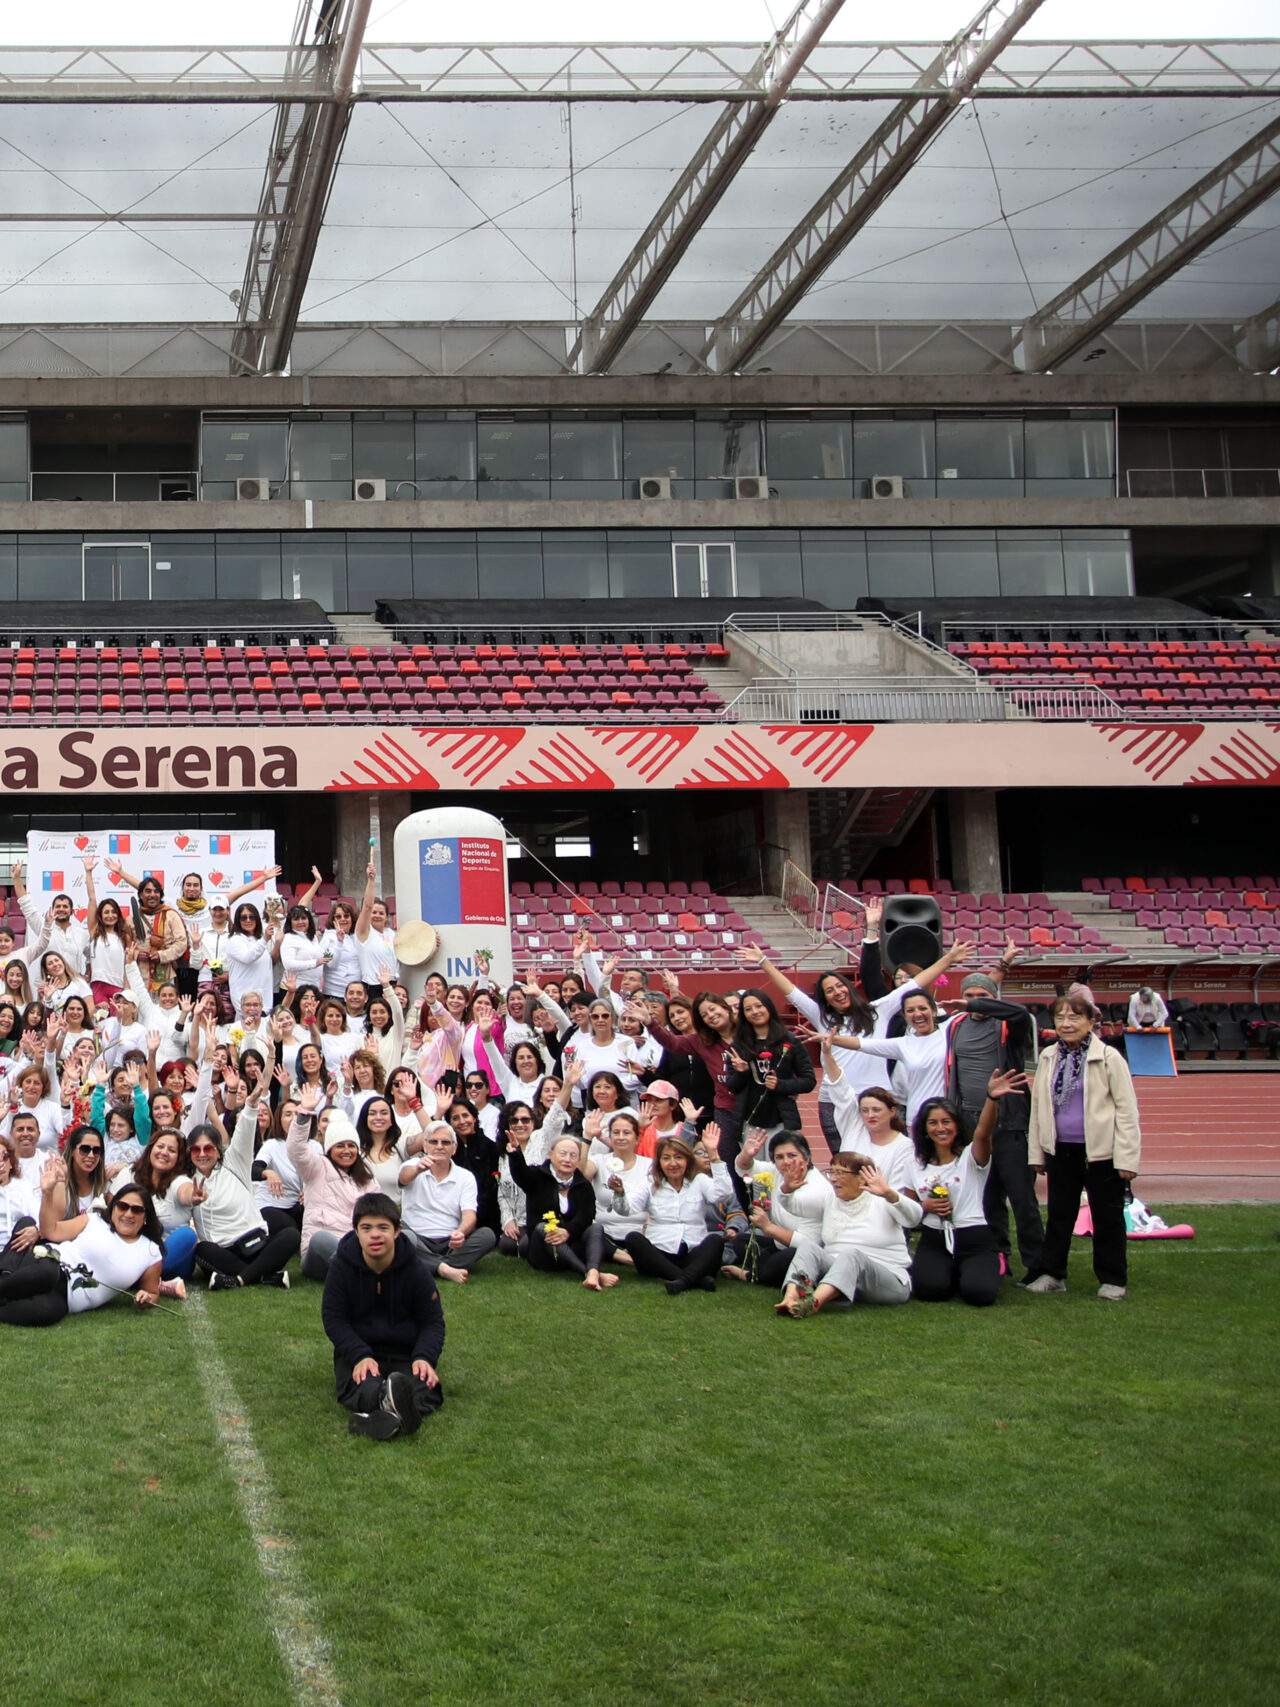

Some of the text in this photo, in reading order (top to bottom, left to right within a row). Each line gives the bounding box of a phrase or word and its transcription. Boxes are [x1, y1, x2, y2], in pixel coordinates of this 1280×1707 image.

[58, 731, 298, 790] Serena
[461, 841, 490, 849] Instituto
[461, 849, 497, 858] Nacional de
[461, 857, 491, 865] Deportes
[1109, 981, 1141, 989] La Serena
